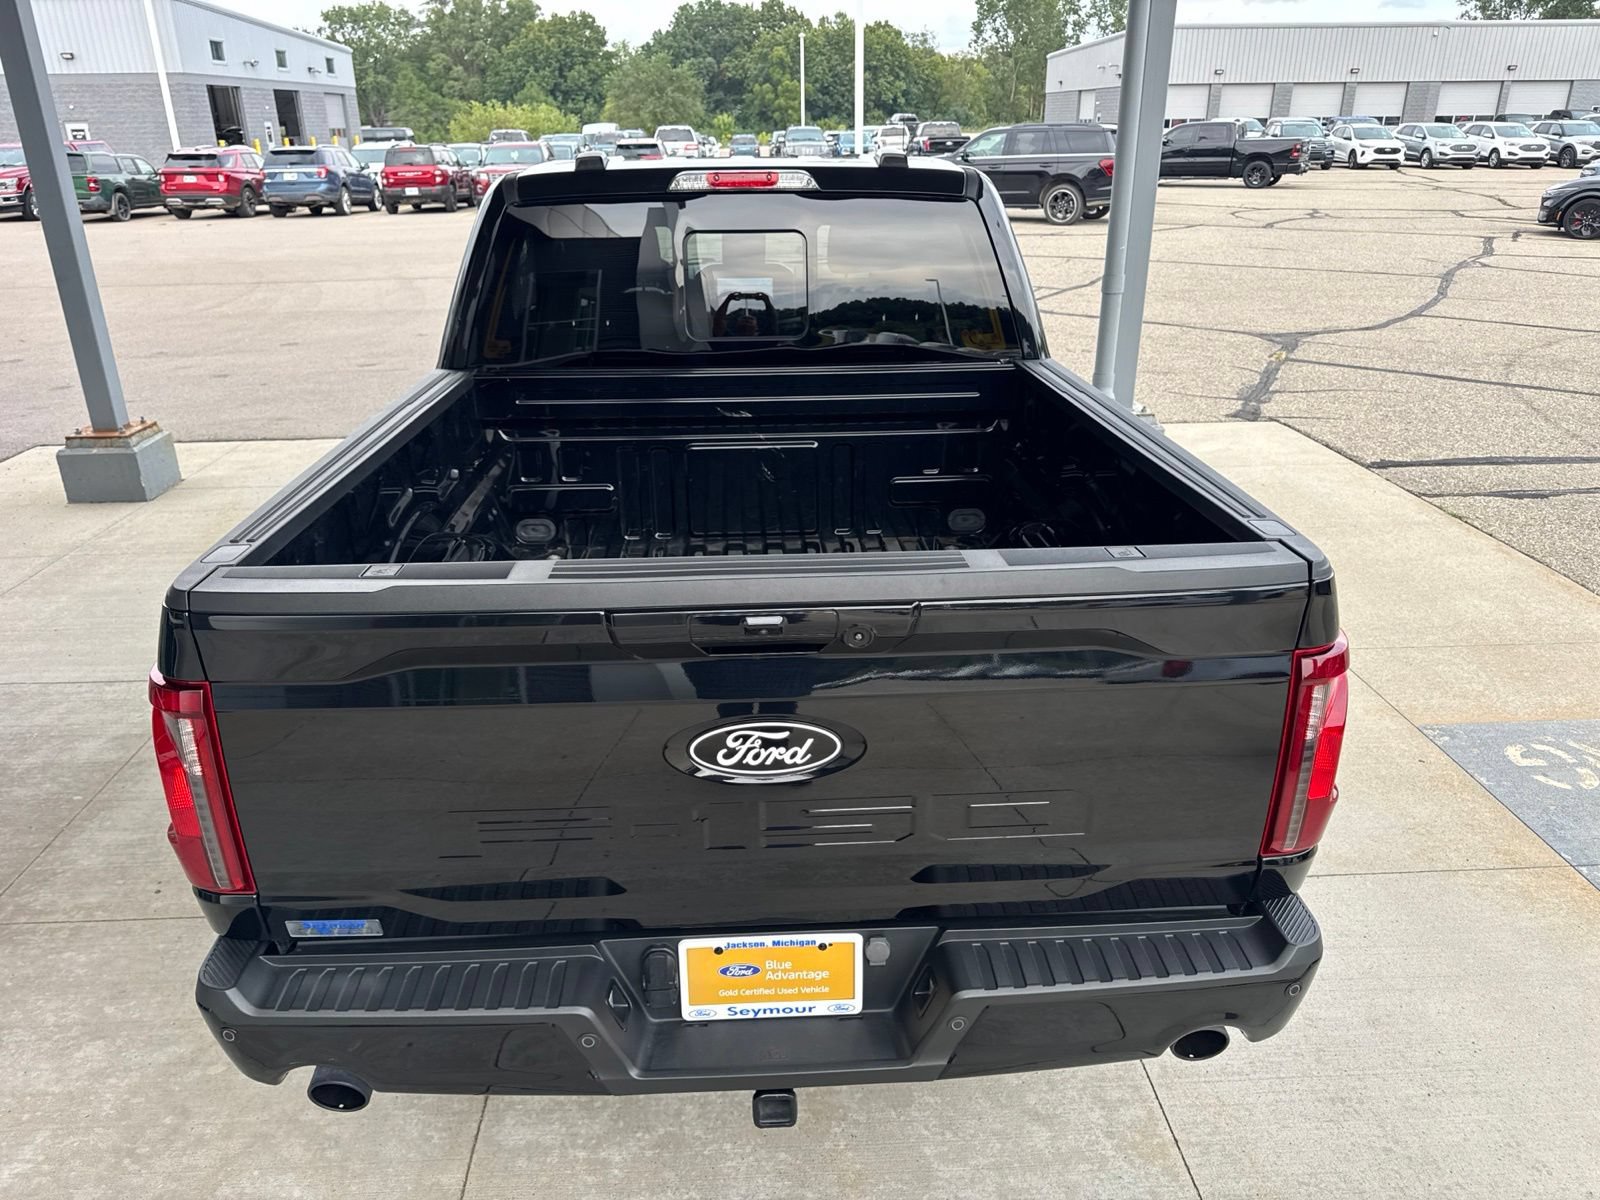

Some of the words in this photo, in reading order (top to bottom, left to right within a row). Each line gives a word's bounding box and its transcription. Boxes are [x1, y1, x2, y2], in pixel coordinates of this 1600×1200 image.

[716, 729, 814, 766] Ford
[772, 939, 816, 947] Michigan
[726, 964, 753, 977] Ford
[765, 960, 792, 969] Blue
[765, 970, 830, 981] Advantage
[719, 989, 738, 997] Gold
[740, 987, 775, 996] Certified
[777, 986, 798, 995] Used
[800, 985, 830, 994] Vehicle
[727, 1005, 816, 1017] Seymour
